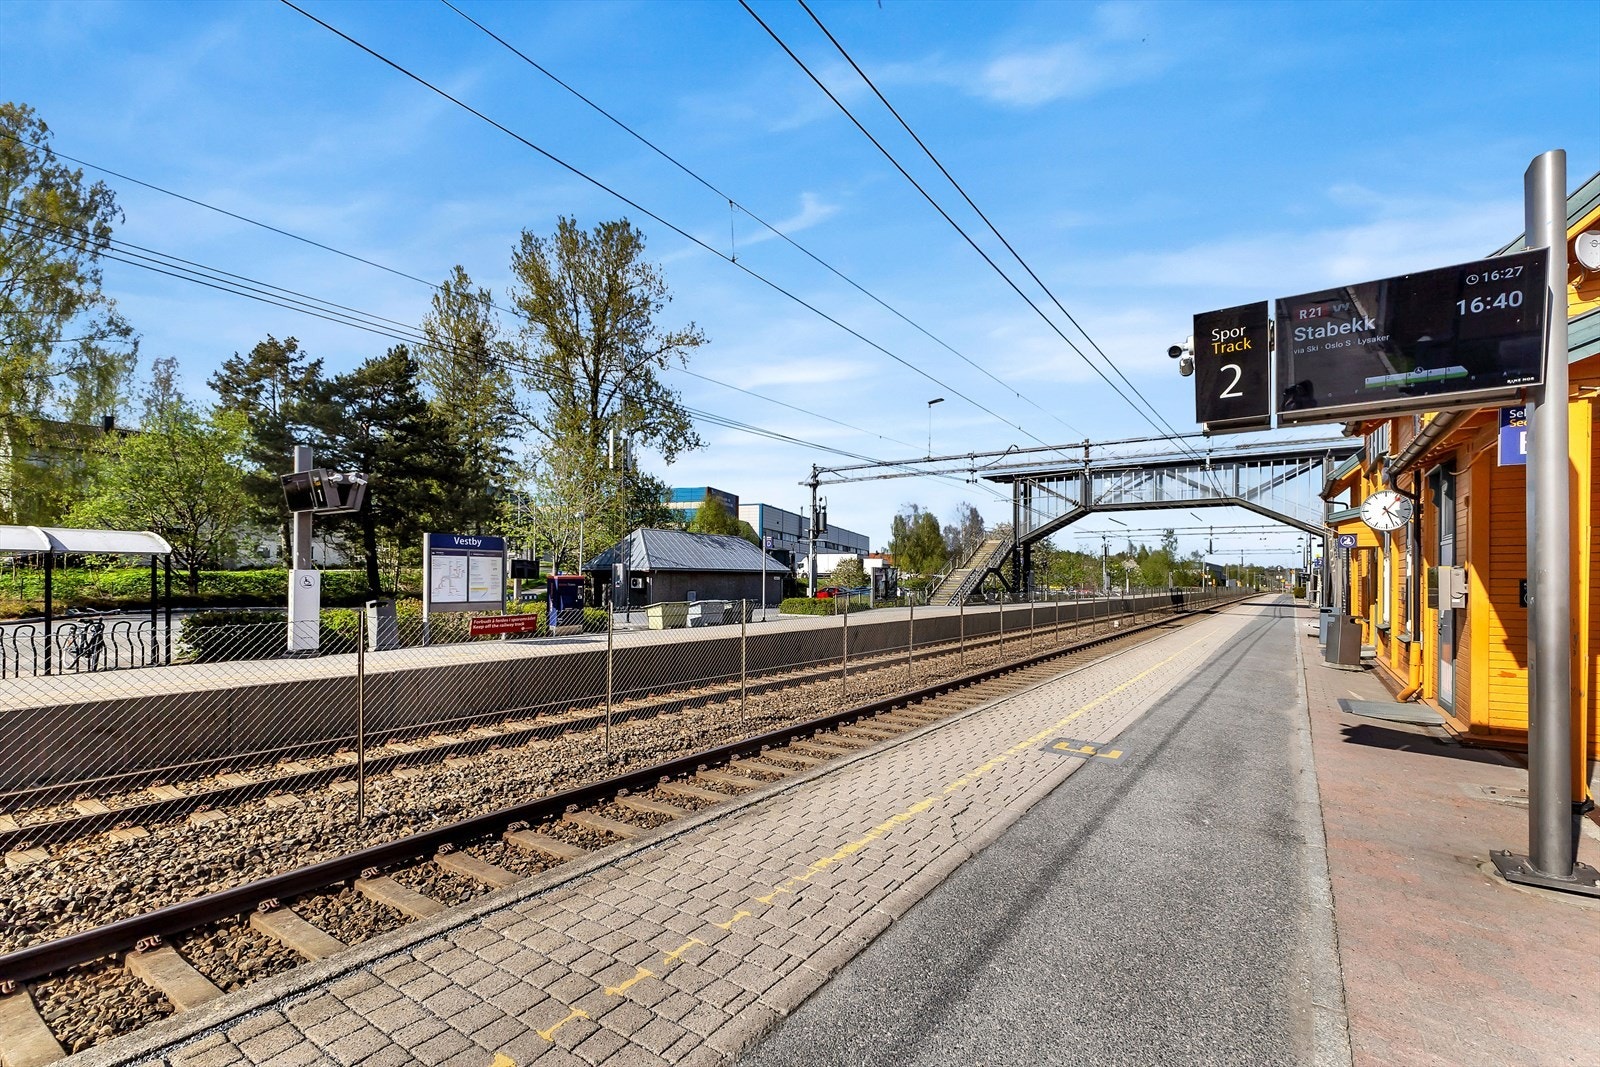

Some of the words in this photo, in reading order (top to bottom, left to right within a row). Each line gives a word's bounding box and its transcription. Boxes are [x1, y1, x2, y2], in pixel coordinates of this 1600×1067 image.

[1482, 265, 1524, 282] 16:27
[1456, 290, 1523, 316] 16:40
[1299, 306, 1322, 320] R21
[1211, 326, 1246, 342] Spor
[1294, 315, 1376, 342] Stabekk
[1211, 337, 1252, 354] Track
[1324, 342, 1344, 350] Oslo
[1358, 334, 1390, 346] Lysaker
[1219, 363, 1244, 399] 2
[453, 536, 482, 547] Vestby
